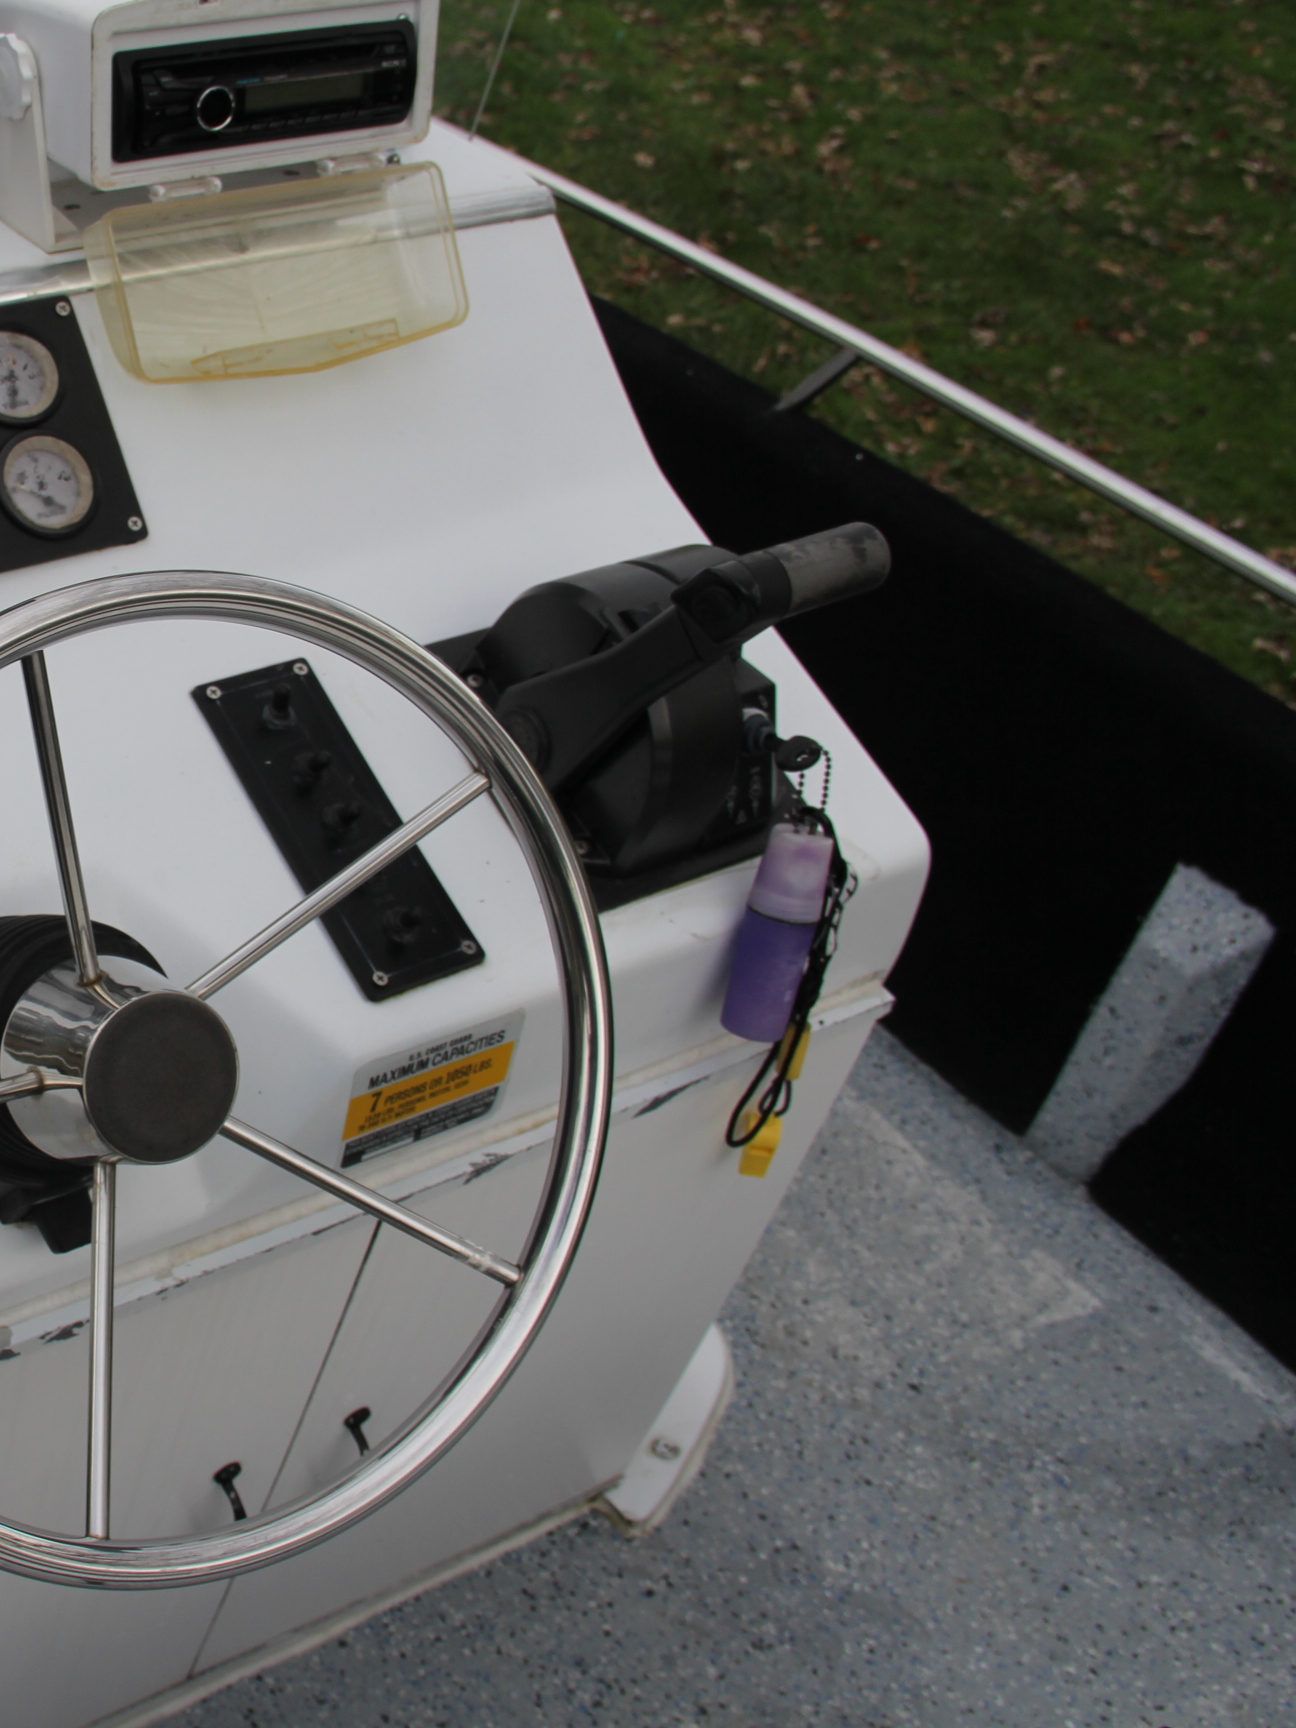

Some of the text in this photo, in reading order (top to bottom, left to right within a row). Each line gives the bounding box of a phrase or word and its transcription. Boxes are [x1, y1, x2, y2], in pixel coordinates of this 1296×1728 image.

[368, 1029, 506, 1090] MAXIMUM CAPACITIES
[370, 1091, 383, 1113] 7
[384, 1081, 428, 1106] PERSONS
